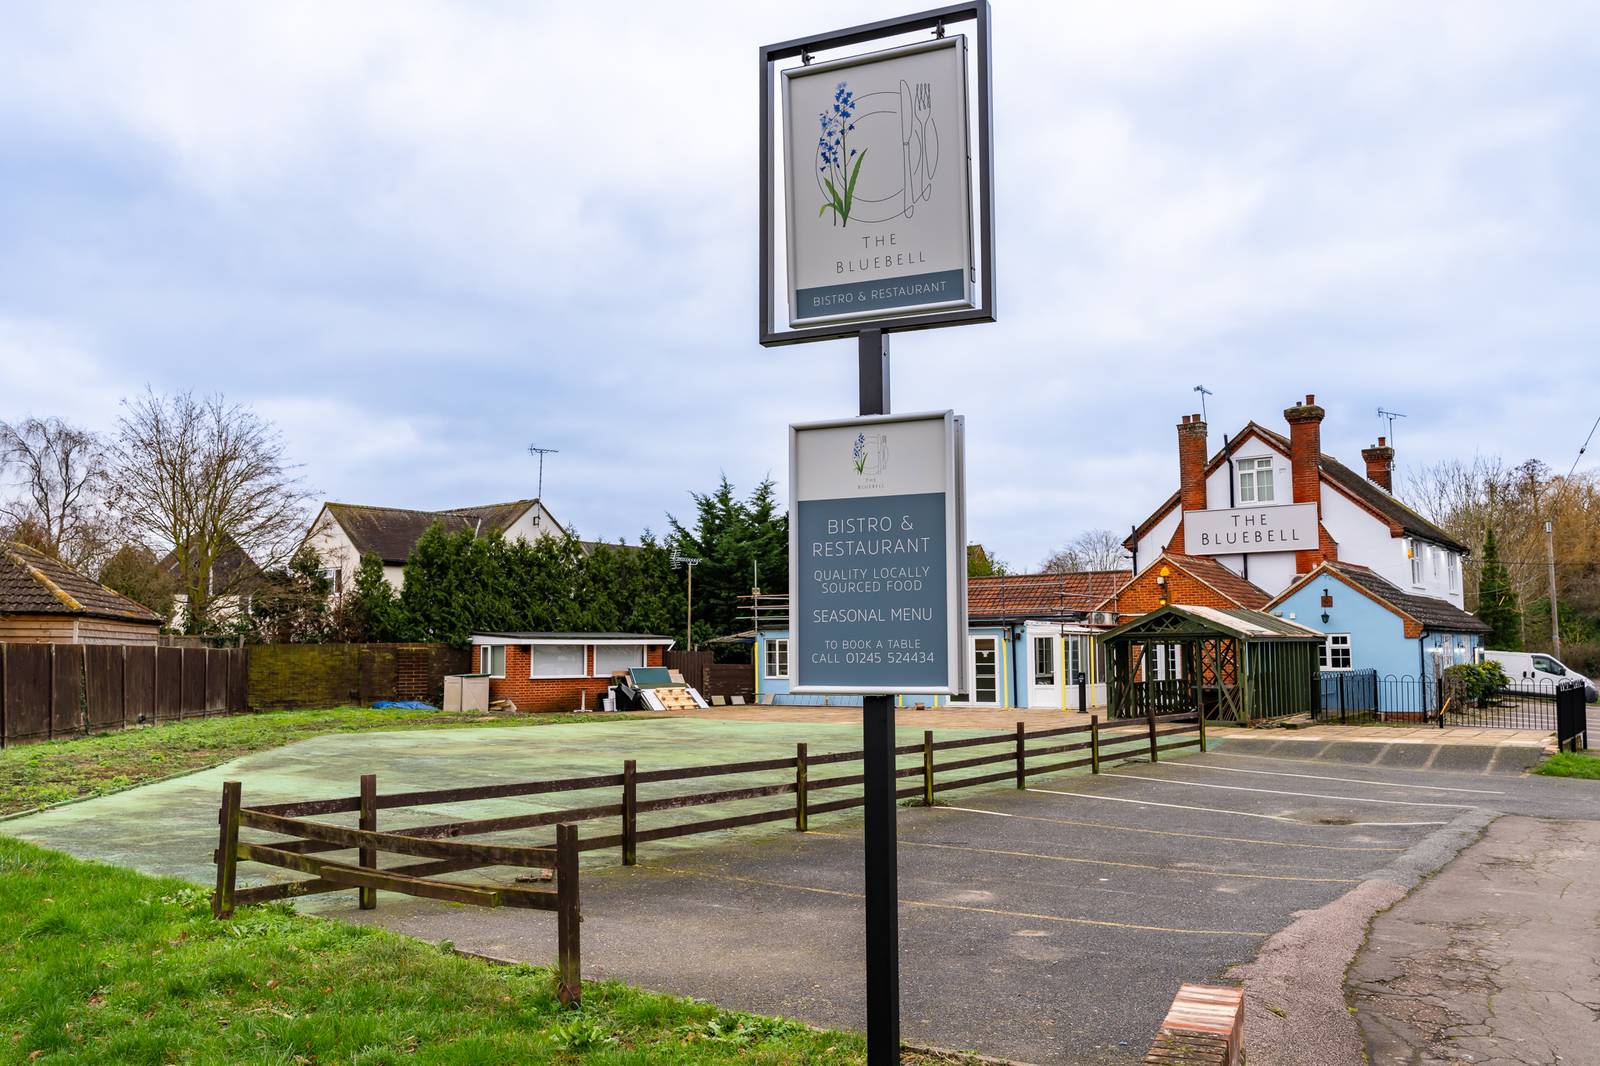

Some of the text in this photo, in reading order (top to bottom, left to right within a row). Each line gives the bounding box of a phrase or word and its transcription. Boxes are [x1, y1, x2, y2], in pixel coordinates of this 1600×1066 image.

[862, 233, 897, 249] THE
[836, 251, 926, 274] BLUEBELL
[813, 281, 946, 307] BISTRO & RESTAURANT
[828, 515, 914, 534] BISTRO &
[1231, 514, 1268, 527] THE
[1201, 529, 1299, 545] BLUEBELL
[813, 537, 930, 557] RESTAURANT
[814, 566, 930, 581] QUALITY LOCALLY
[822, 580, 922, 594] SOURCED FOOD
[813, 607, 932, 623] SEASONAL MENU
[825, 639, 921, 650] TO BOOK A TABLE
[812, 652, 935, 664] CALL 01245 524434
